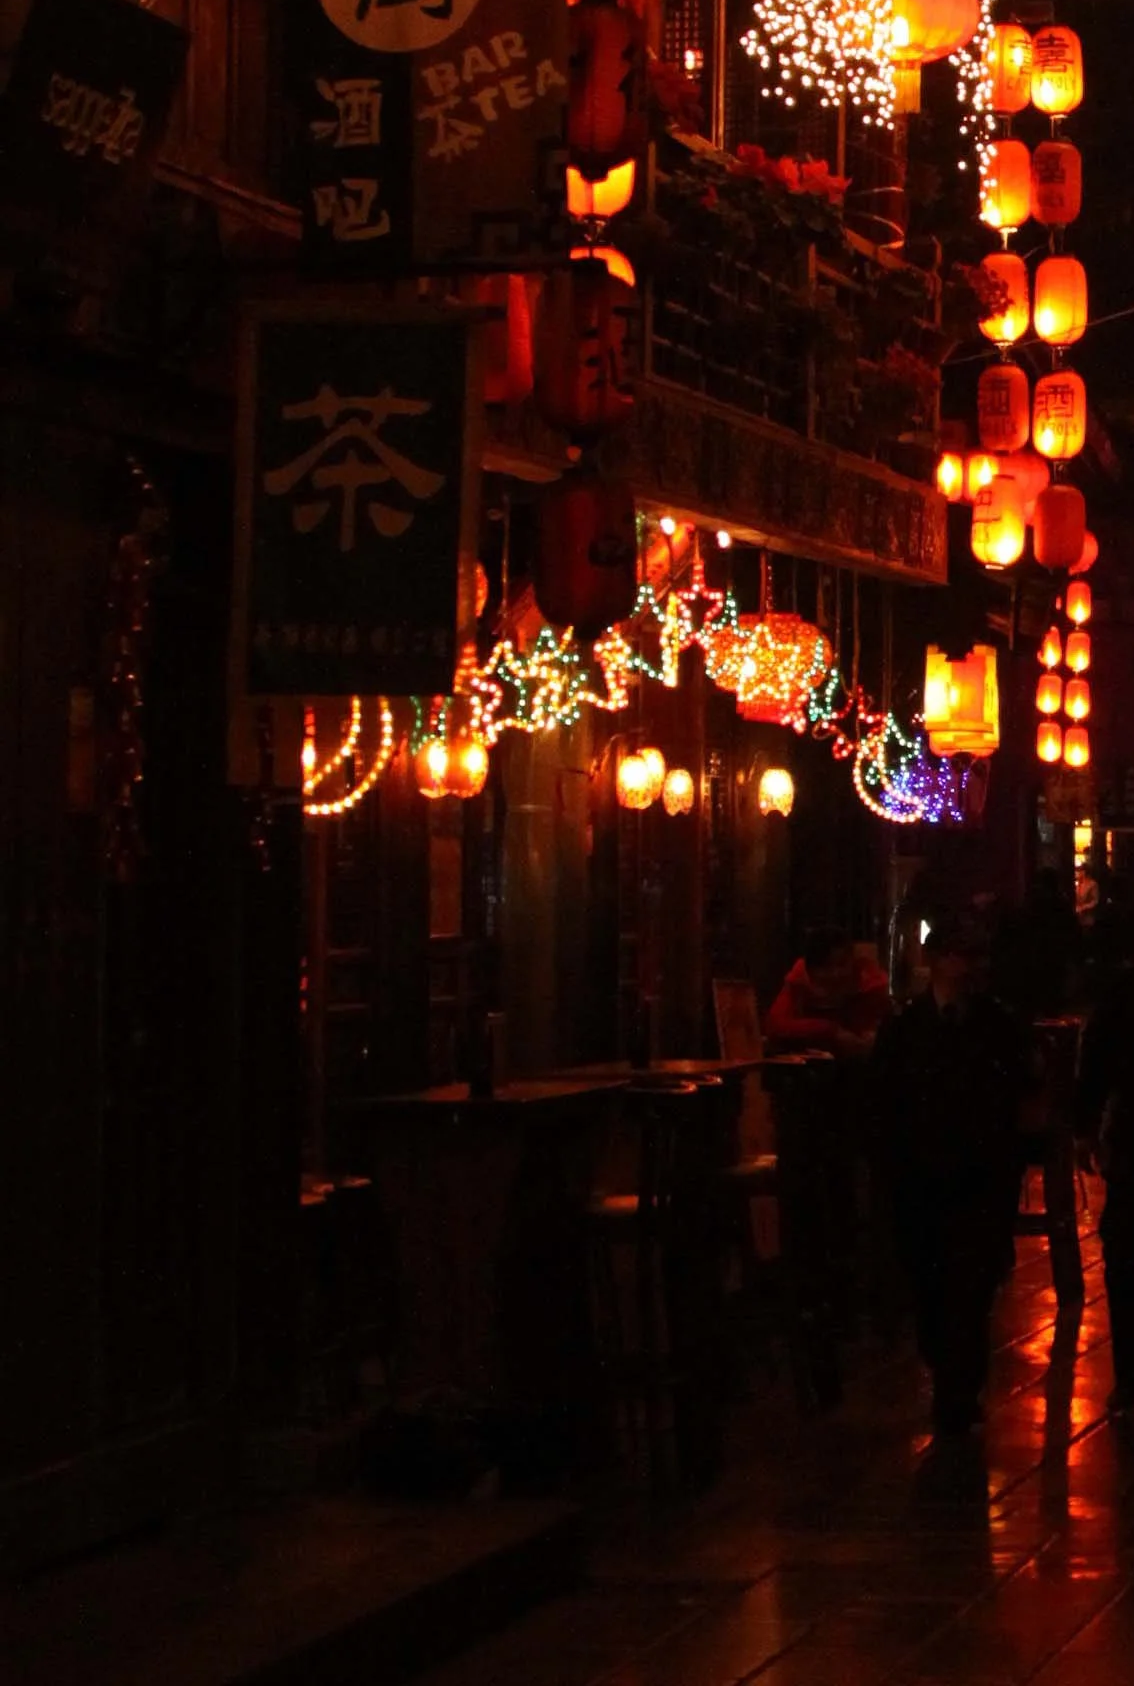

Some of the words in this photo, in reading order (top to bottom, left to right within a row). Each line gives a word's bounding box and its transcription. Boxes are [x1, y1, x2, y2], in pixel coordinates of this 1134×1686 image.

[421, 30, 529, 98] BAR
[469, 58, 568, 122] TEA
[308, 76, 391, 242] 酒吧
[1034, 384, 1074, 419] 酒
[262, 382, 447, 552] 茶
